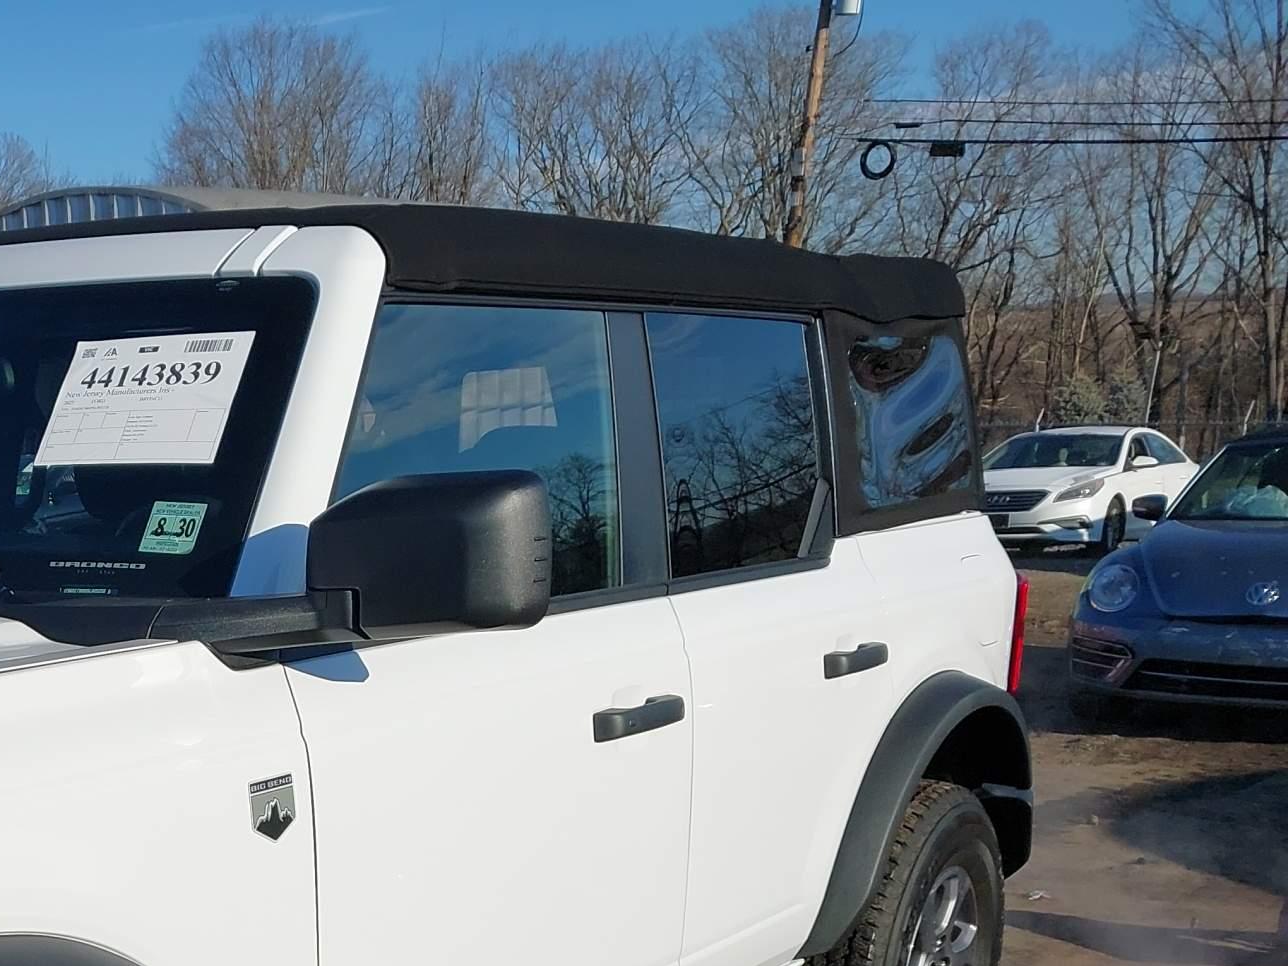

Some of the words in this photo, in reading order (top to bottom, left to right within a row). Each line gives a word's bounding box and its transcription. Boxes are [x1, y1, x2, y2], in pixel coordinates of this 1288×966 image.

[80, 360, 223, 389] 44143839
[106, 388, 156, 396] Manufacturers
[154, 517, 168, 537] 8
[176, 517, 197, 537] 30
[250, 782, 267, 793] BIG
[267, 775, 292, 788] BEND
